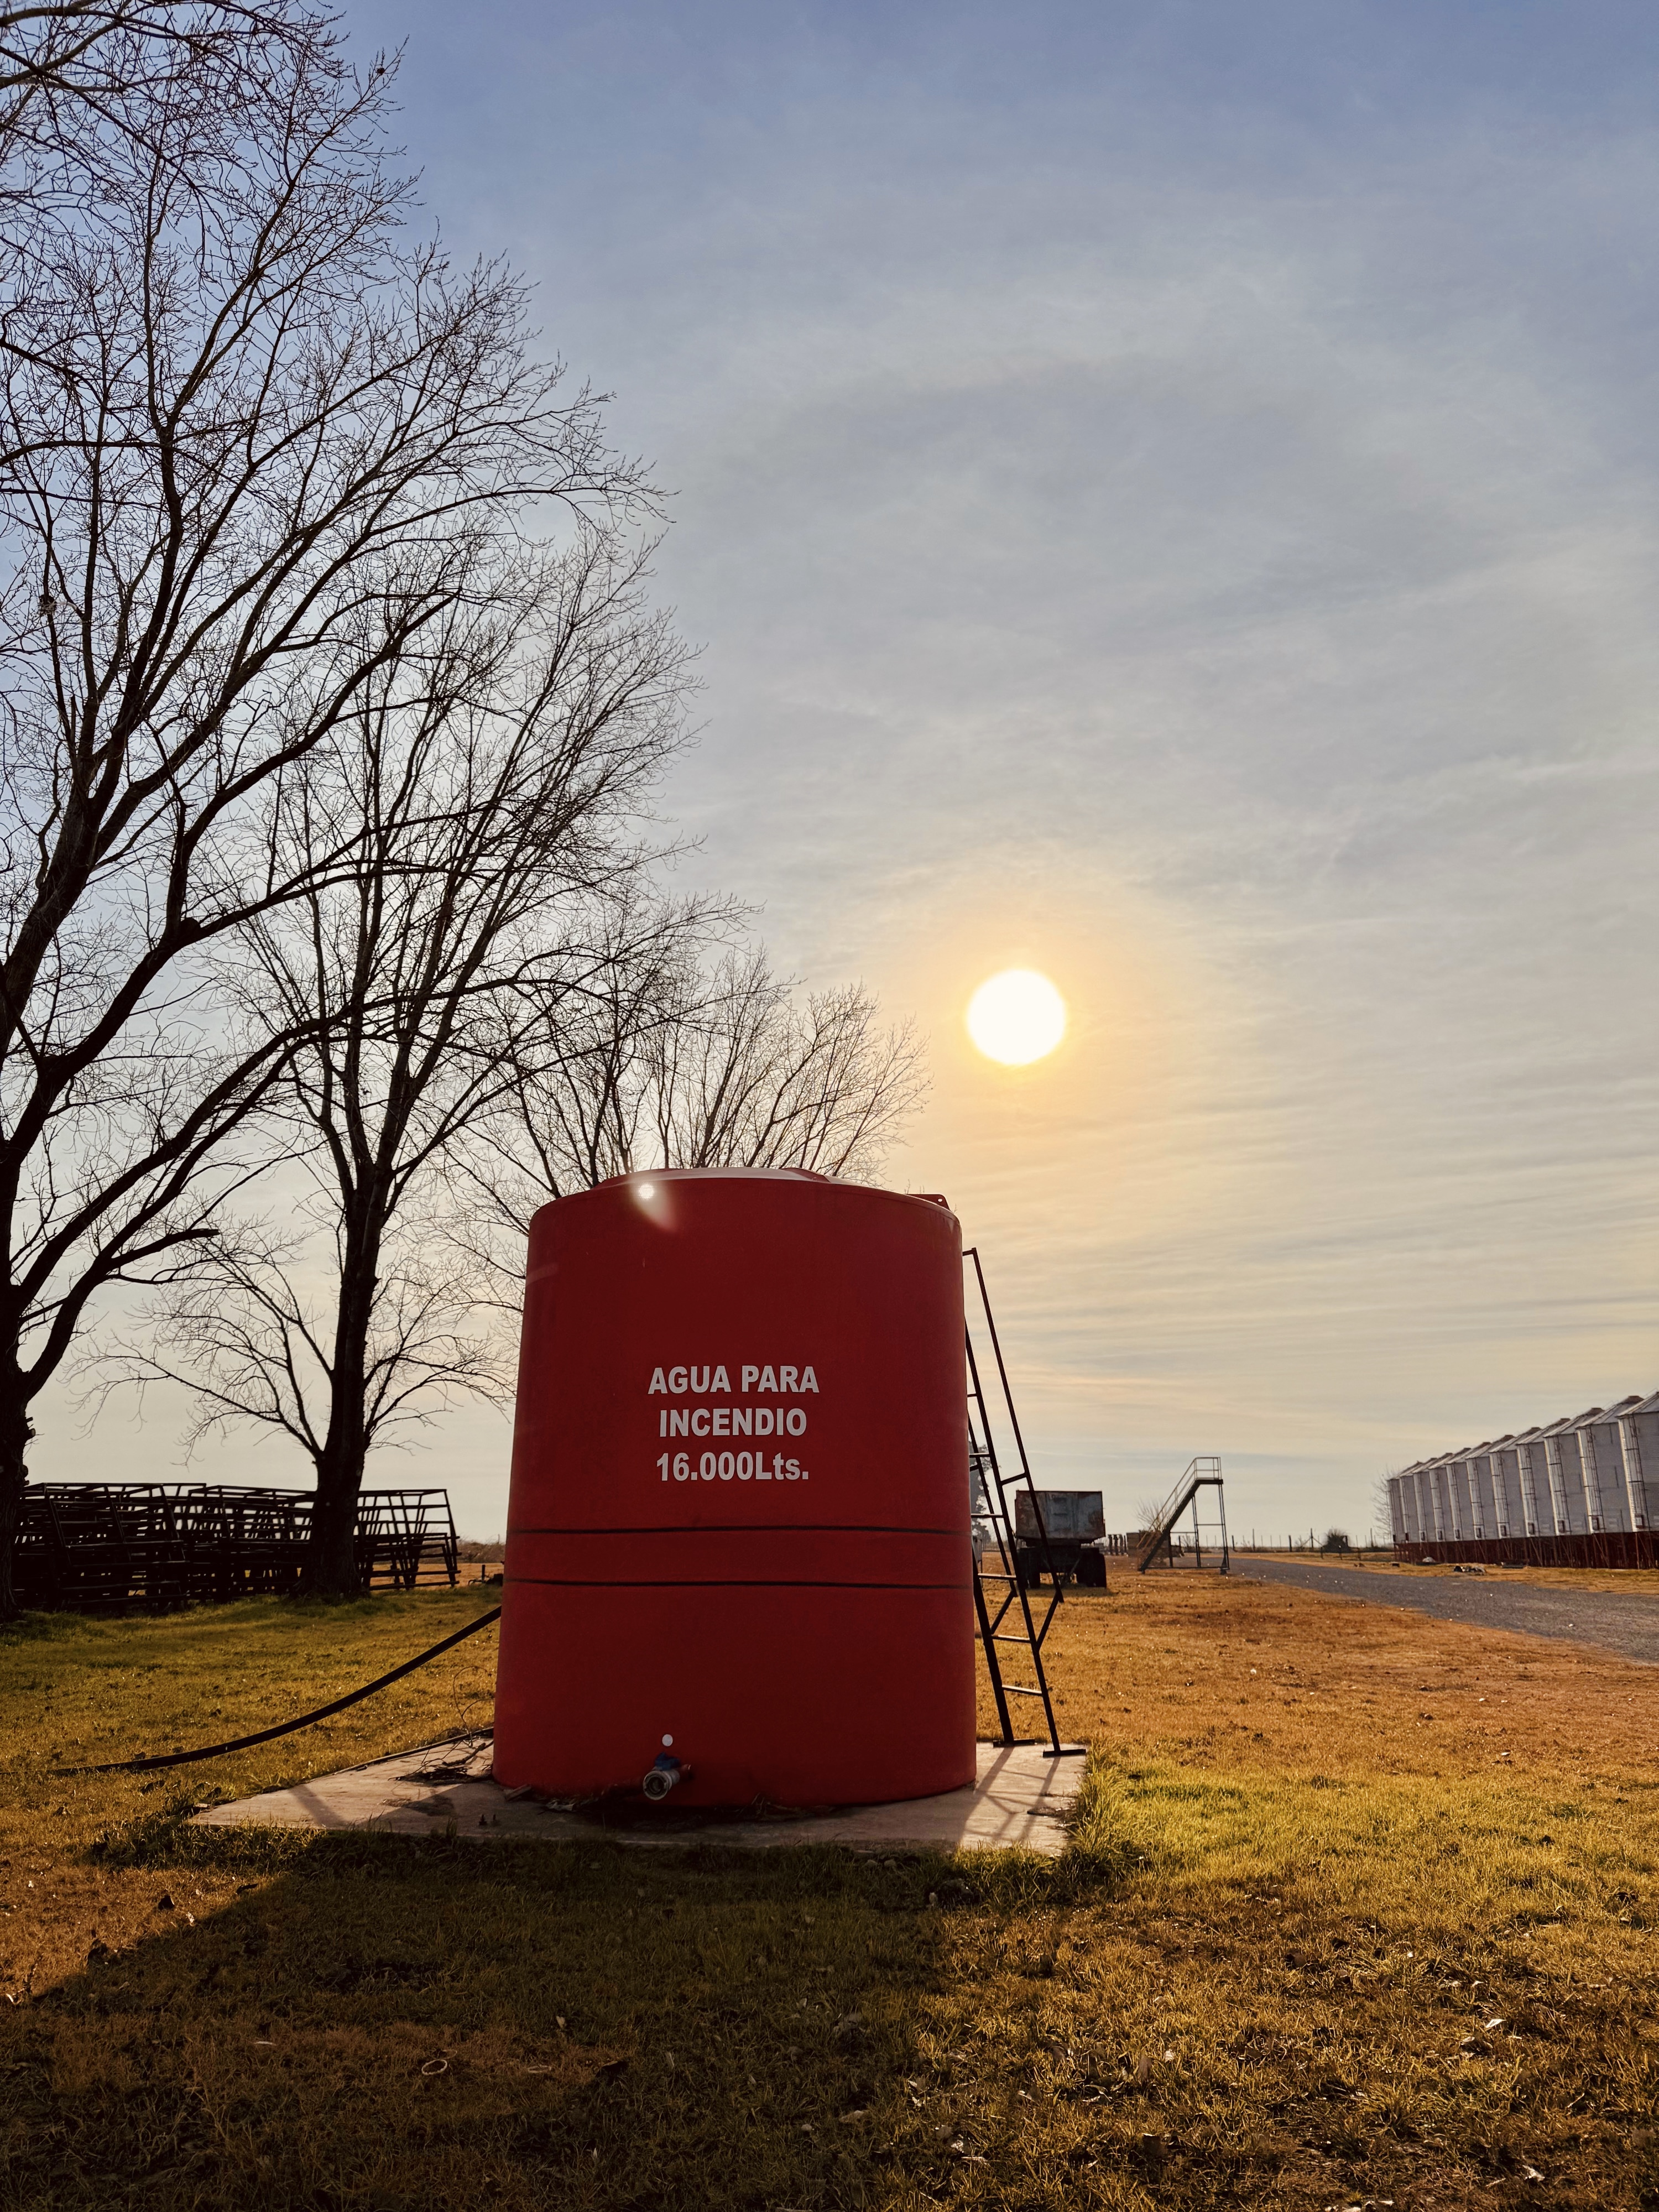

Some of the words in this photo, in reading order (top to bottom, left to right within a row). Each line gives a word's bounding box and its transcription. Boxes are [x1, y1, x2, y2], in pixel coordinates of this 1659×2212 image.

[648, 1365, 732, 1394] AGUA
[742, 1365, 820, 1393] PARA
[660, 1408, 807, 1437] INCENDIO
[656, 1451, 808, 1481] 16.000Lts.
